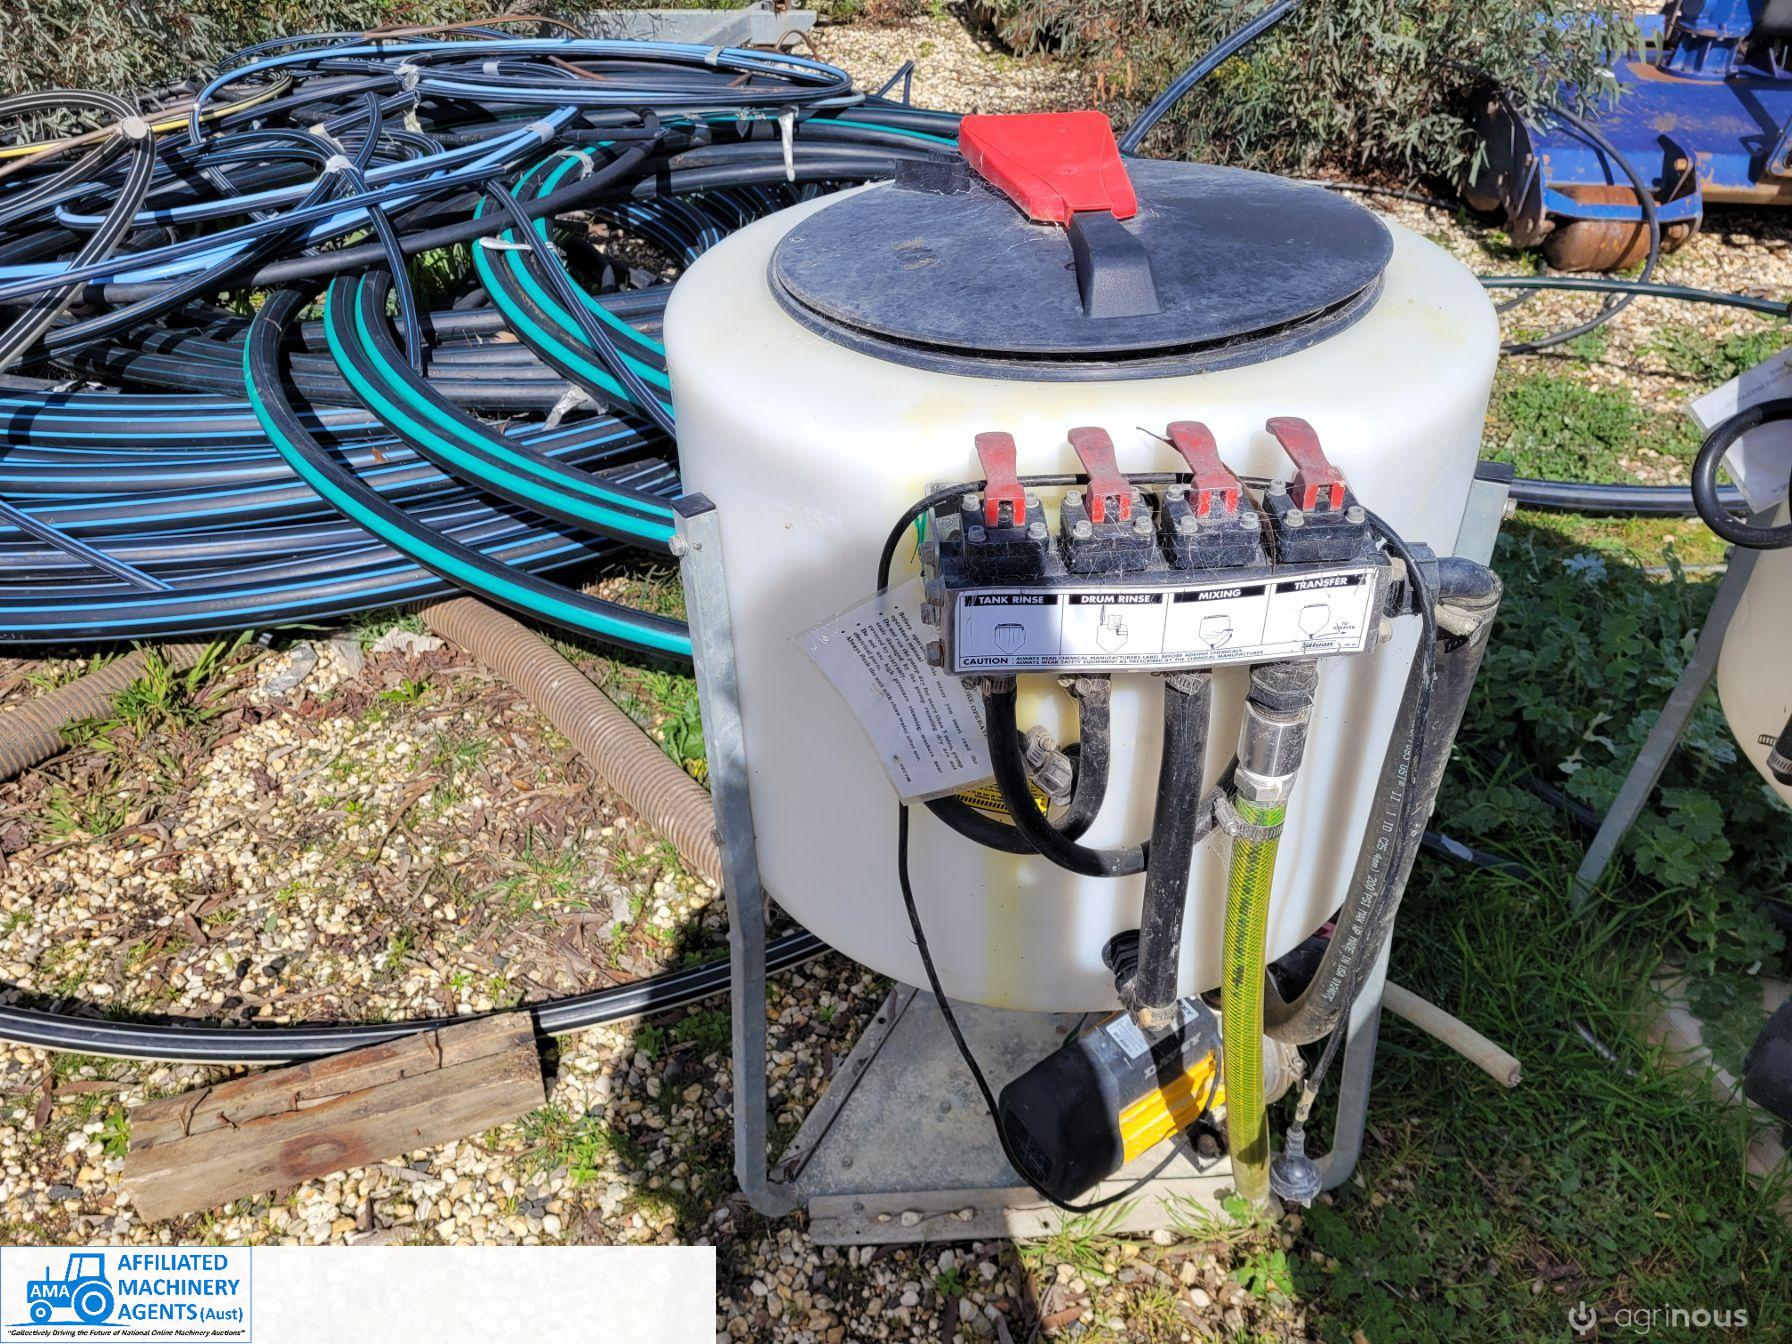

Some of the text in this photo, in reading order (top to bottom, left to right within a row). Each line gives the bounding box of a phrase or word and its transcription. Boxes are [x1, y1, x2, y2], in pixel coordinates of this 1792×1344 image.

[1294, 577, 1348, 590] TRANSFER
[978, 594, 1044, 604] TANK RINSE
[1081, 595, 1150, 604] DRUM RINSE
[1198, 588, 1242, 601] MIXING
[852, 631, 872, 655] electrical
[868, 624, 884, 646] covered
[881, 646, 889, 654] by
[889, 614, 923, 662] operators manual
[963, 657, 1008, 665] CAUTION
[845, 635, 861, 654] Always
[859, 653, 871, 667] flush
[868, 667, 876, 676] the
[874, 676, 885, 688] unit
[882, 688, 892, 700] with
[888, 699, 902, 716] clean
[897, 716, 909, 734] water
[905, 734, 916, 750] after
[875, 621, 886, 635] seals
[885, 637, 904, 662] damaged
[902, 663, 909, 671] by
[908, 673, 916, 683] the
[913, 685, 926, 704] pump
[923, 706, 938, 732] running
[935, 733, 944, 745] dry
[949, 760, 957, 771] not
[882, 618, 891, 627] Do
[888, 627, 897, 637] not
[894, 638, 903, 648] run
[902, 648, 910, 657] the
[906, 657, 920, 675] pump
[917, 674, 925, 686] dry
[922, 686, 931, 696] for
[927, 697, 938, 714] more
[934, 713, 945, 729] than
[951, 751, 963, 769] pump
[898, 611, 912, 630] Before
[944, 702, 953, 715] you
[952, 718, 962, 734] must
[961, 736, 971, 751] read
[970, 754, 979, 765] the
[860, 627, 868, 637] Do
[868, 638, 877, 648] not
[876, 651, 884, 660] use
[883, 662, 894, 675] high
[892, 677, 909, 702] pressure
[908, 704, 922, 731] cleaning
[933, 760, 943, 774] near
[1364, 874, 1377, 890] 200
[1359, 892, 1373, 907] PSI
[1354, 907, 1368, 923] MAX
[1343, 935, 1358, 953] MADE
[1335, 964, 1348, 977] USA
